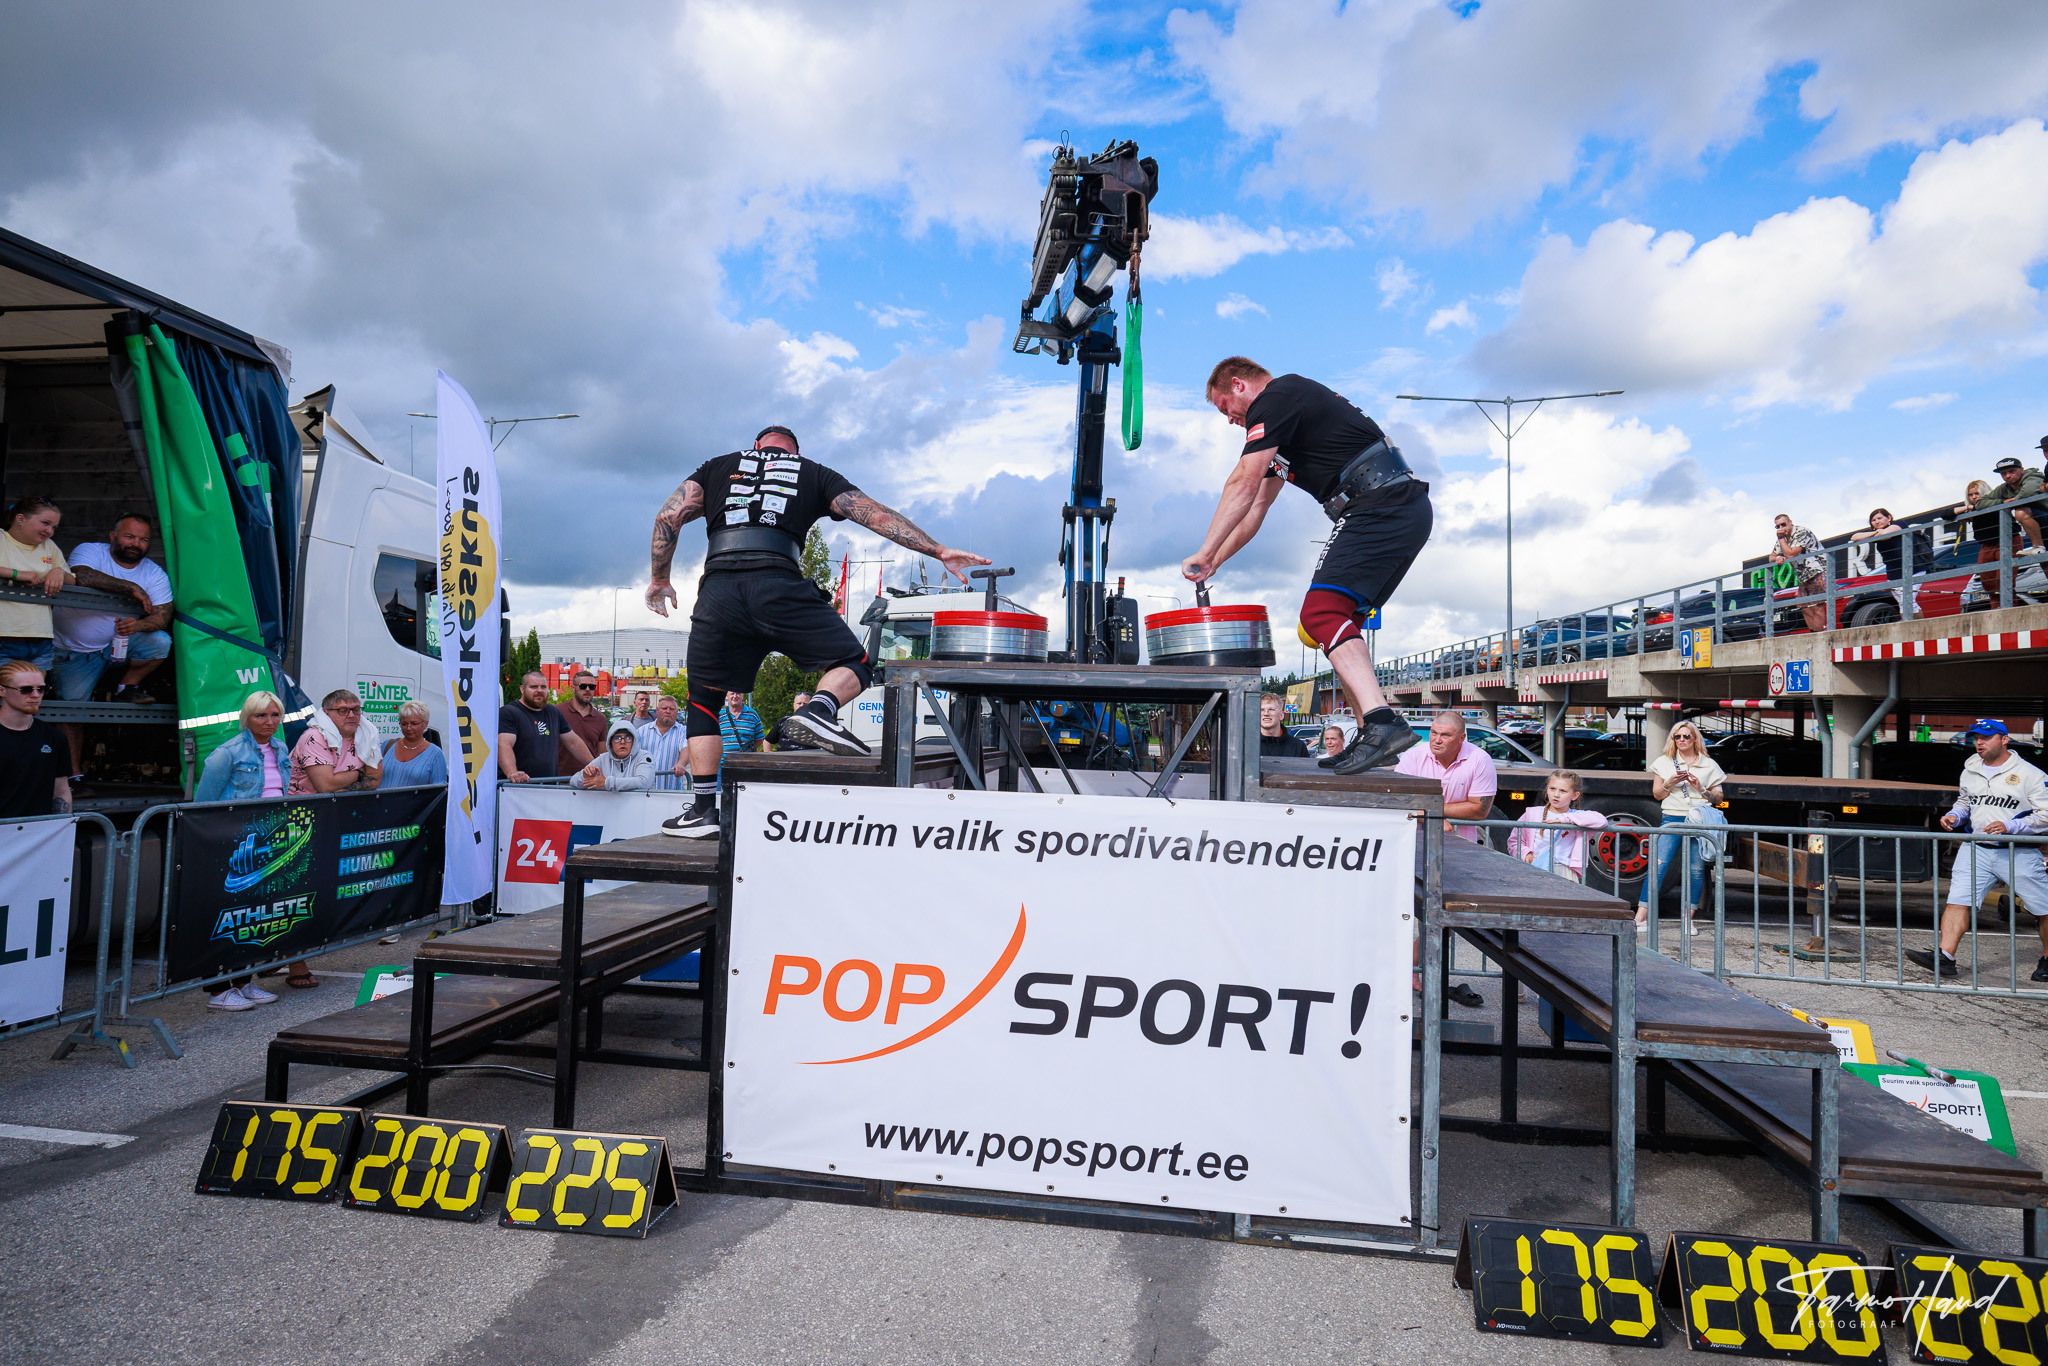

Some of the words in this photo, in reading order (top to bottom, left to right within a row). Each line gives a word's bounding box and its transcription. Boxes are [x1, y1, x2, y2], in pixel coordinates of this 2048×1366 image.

[338, 850, 395, 876] HUMAN
[340, 824, 421, 850] ENGINEERING
[516, 838, 559, 868] 24
[763, 810, 898, 848] Suurim
[912, 818, 1002, 853] valik
[1014, 826, 1382, 872] spordivahendeid!
[216, 896, 309, 934] ATHLETE
[238, 917, 289, 940] BYTES
[763, 954, 946, 1025] POP
[1881, 1077, 1904, 1085] Suurim
[232, 1110, 344, 1195] 175
[349, 1119, 491, 1211] 200
[506, 1135, 653, 1228] 225
[864, 1122, 1250, 1182] www.popsport.ee
[1515, 1228, 1656, 1339] 175
[1690, 1240, 1882, 1357] 200
[1911, 1255, 2048, 1366] 22
